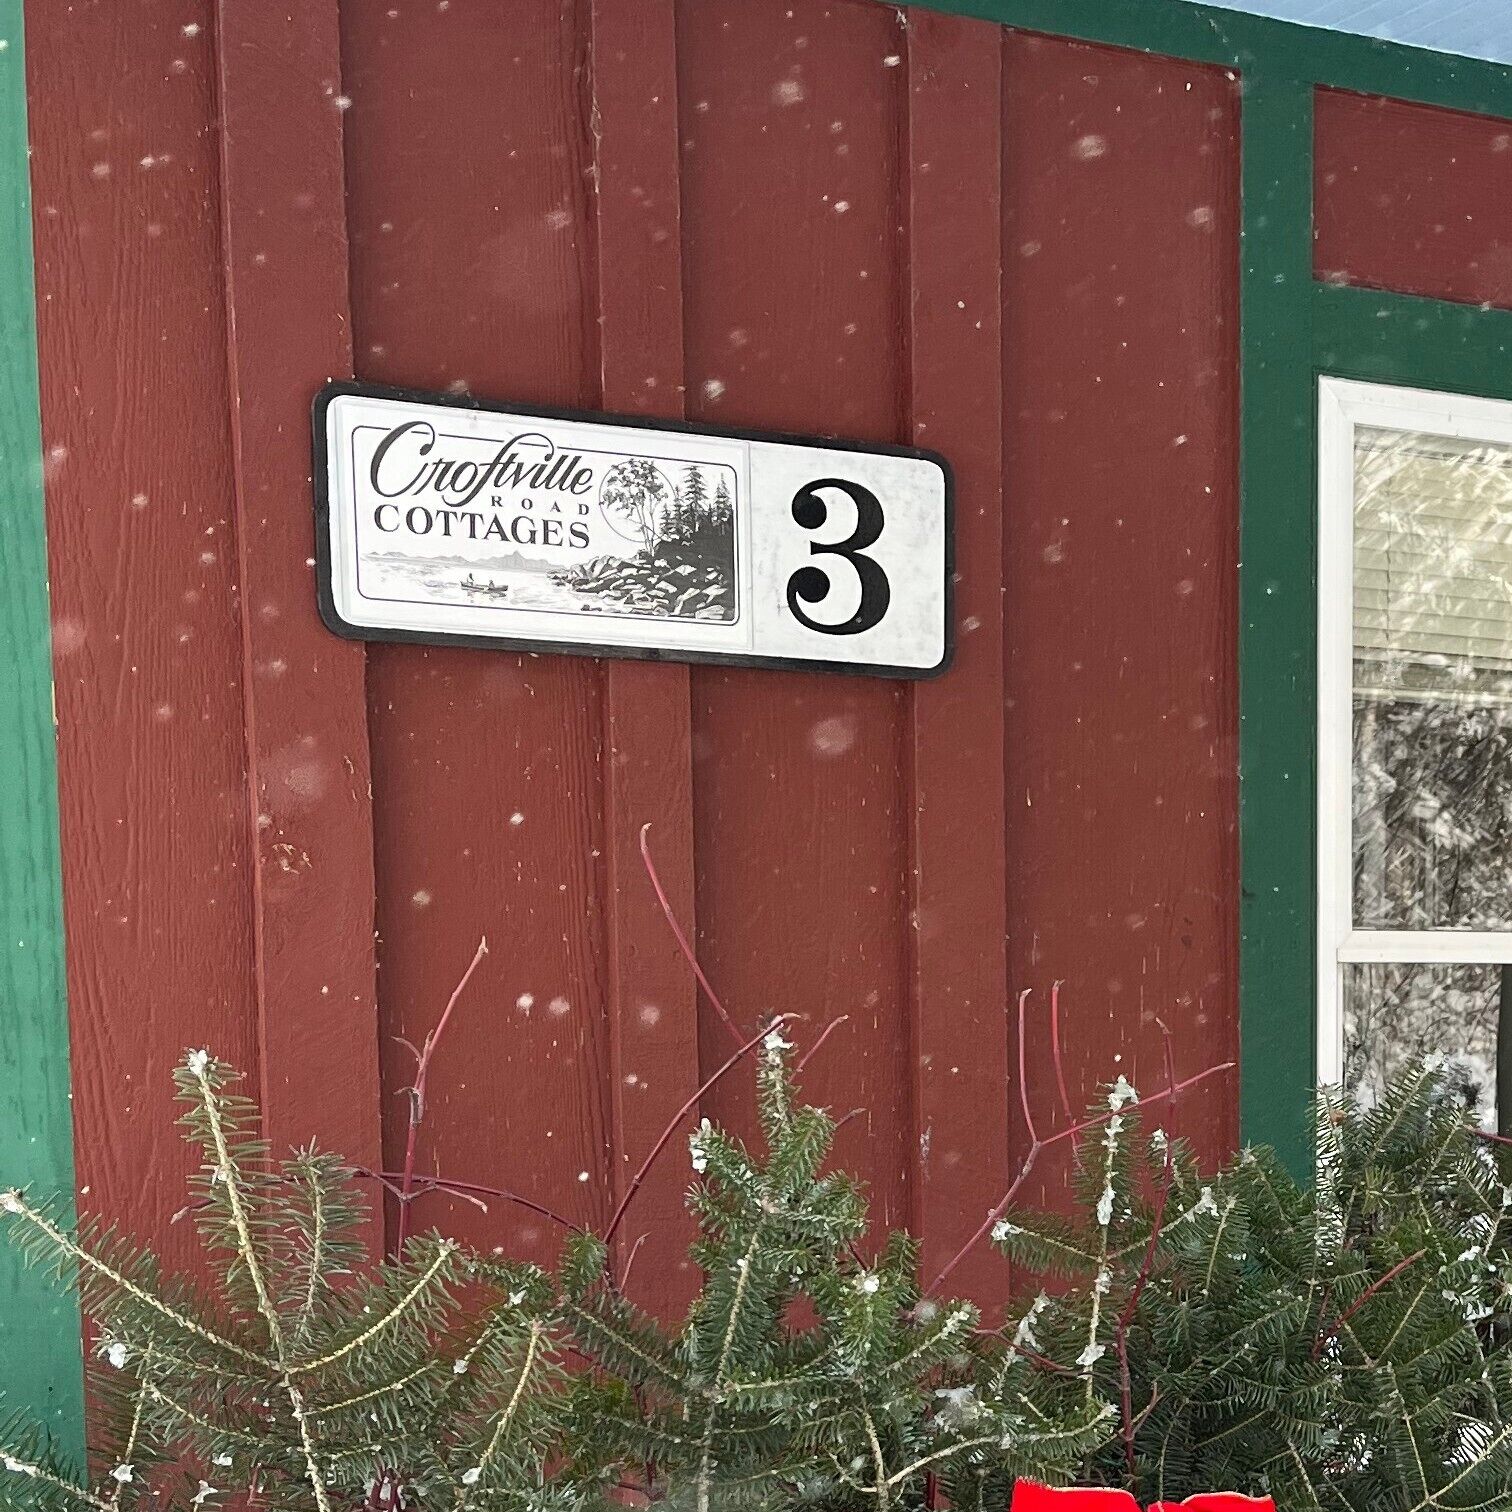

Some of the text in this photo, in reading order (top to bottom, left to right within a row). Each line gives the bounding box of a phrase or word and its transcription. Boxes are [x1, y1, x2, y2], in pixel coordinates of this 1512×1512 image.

[370, 421, 593, 507] Croftville
[374, 503, 590, 549] COTTAGES
[491, 495, 590, 516] ROAD
[787, 478, 890, 635] 3
